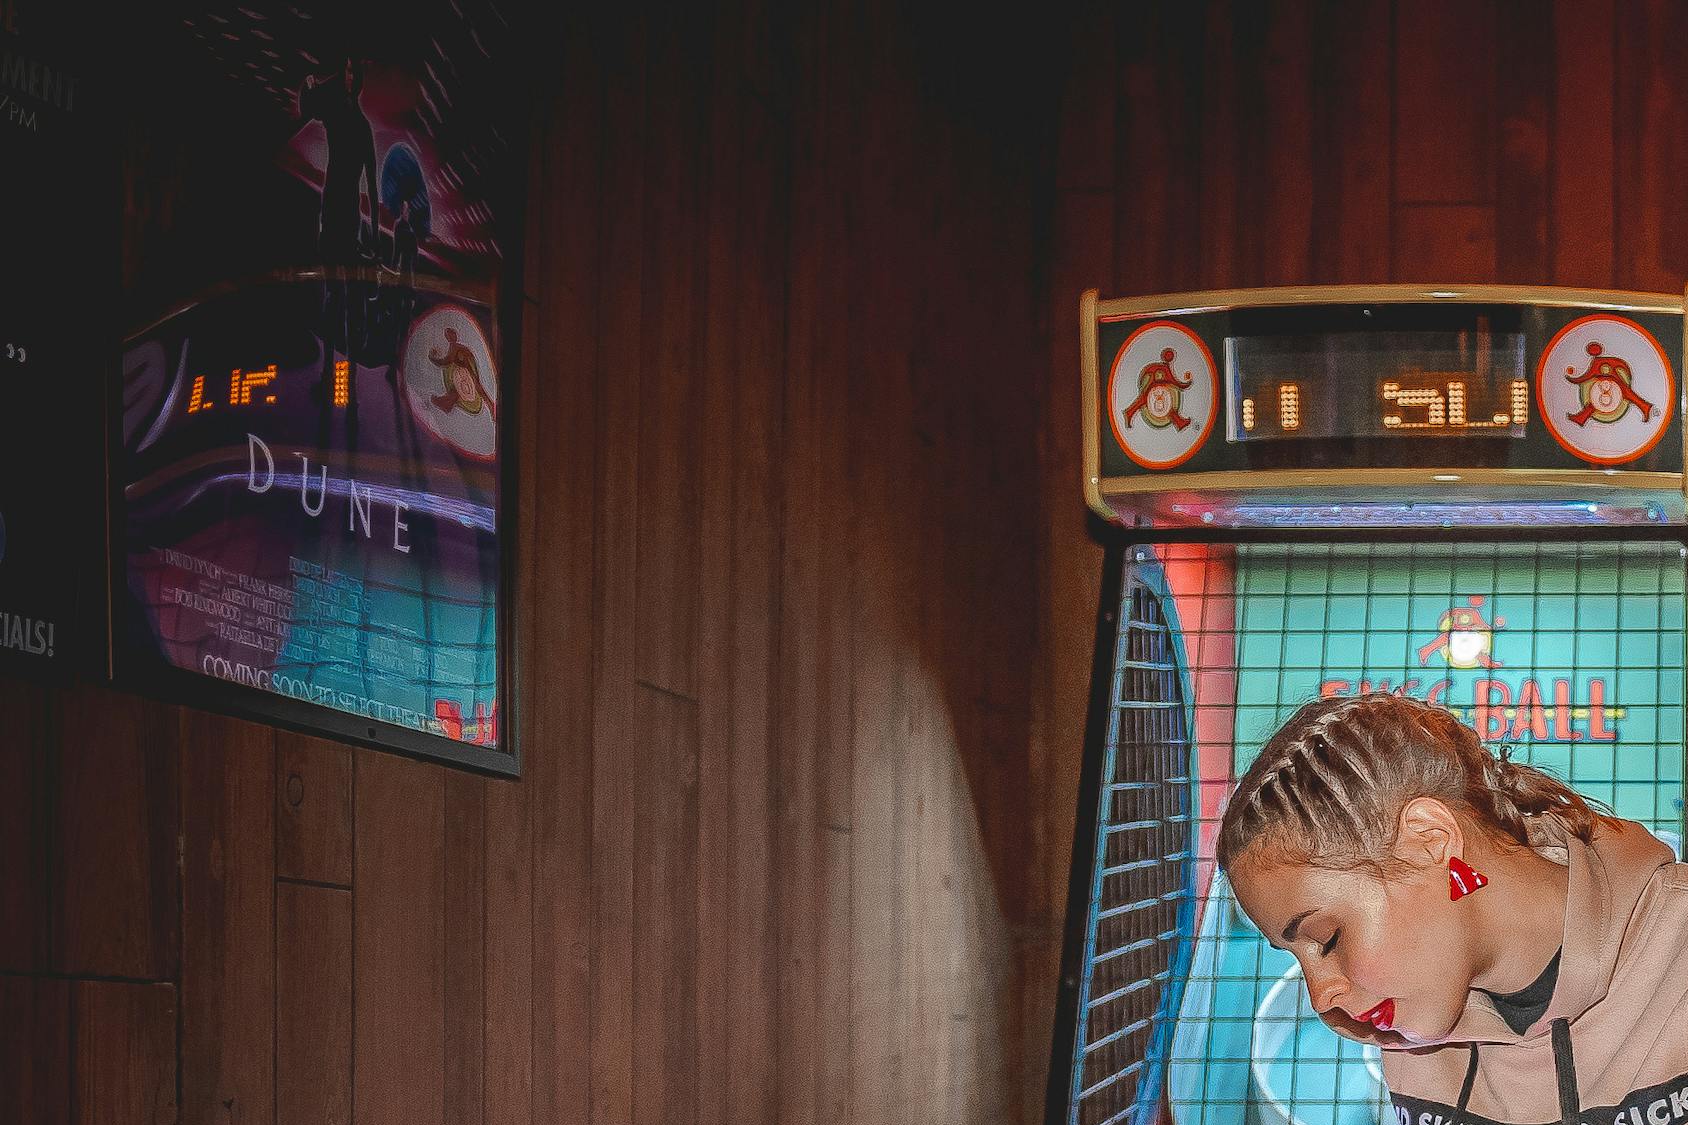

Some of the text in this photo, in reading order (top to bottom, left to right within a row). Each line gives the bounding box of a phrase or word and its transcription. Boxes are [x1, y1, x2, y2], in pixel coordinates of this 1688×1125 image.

[248, 433, 410, 553] DUNE
[0, 611, 55, 657] IALS!
[203, 654, 270, 690] COMING
[271, 673, 316, 702] SOON
[315, 685, 336, 708] TO
[1473, 678, 1618, 741] BALL
